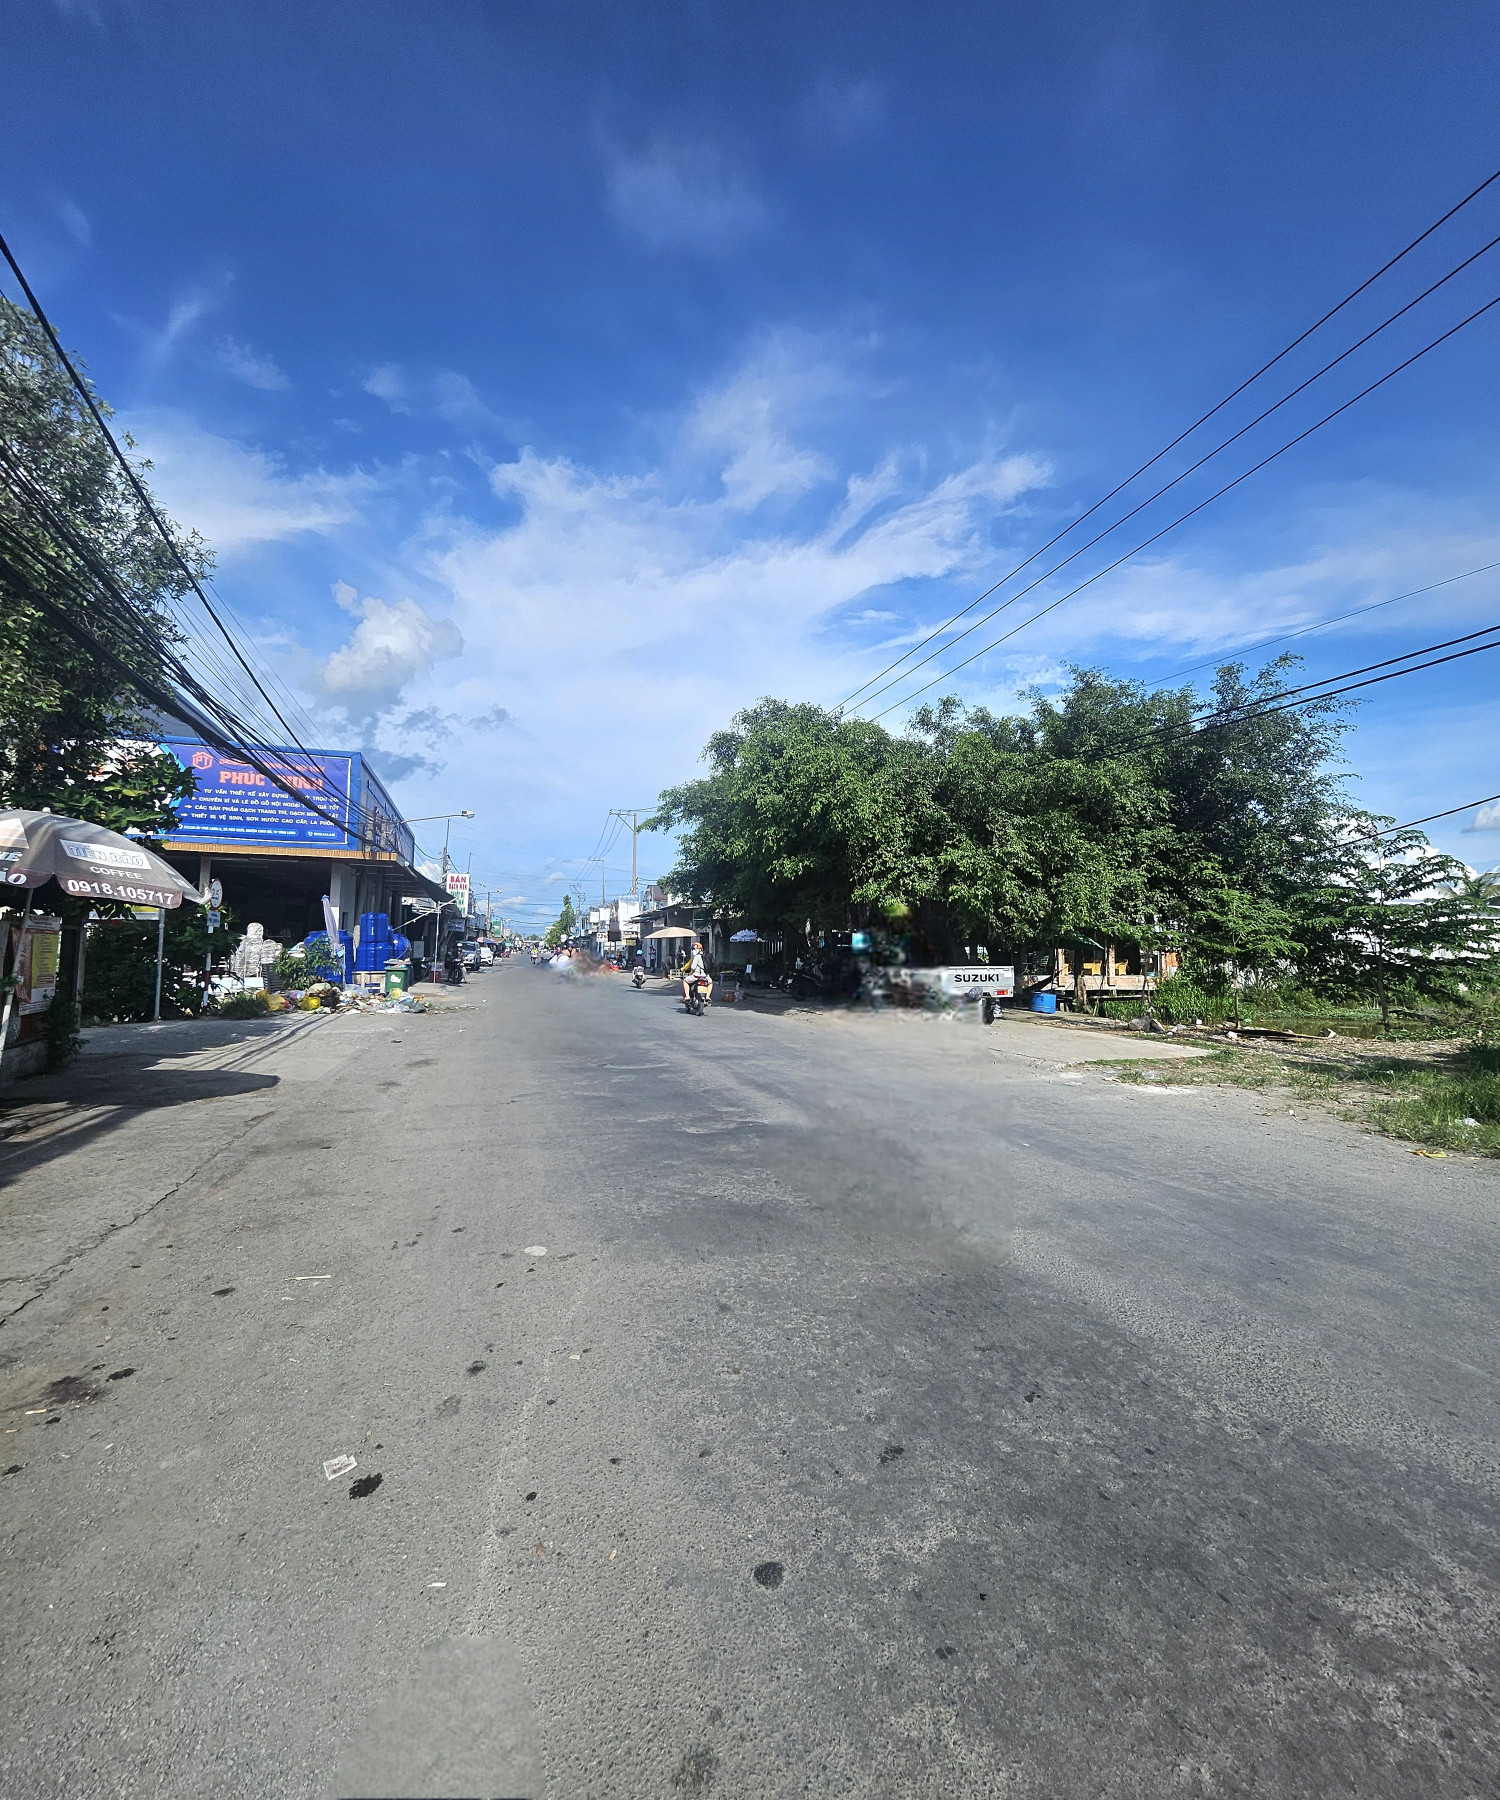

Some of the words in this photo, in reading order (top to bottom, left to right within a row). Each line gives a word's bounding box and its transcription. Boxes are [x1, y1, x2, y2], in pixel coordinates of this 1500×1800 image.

[219, 770, 267, 786] PHÚC
[89, 866, 144, 880] COFFEE
[450, 875, 467, 883] BÁN
[67, 879, 175, 905] 0918.105717
[954, 973, 999, 983] SUZUKI
